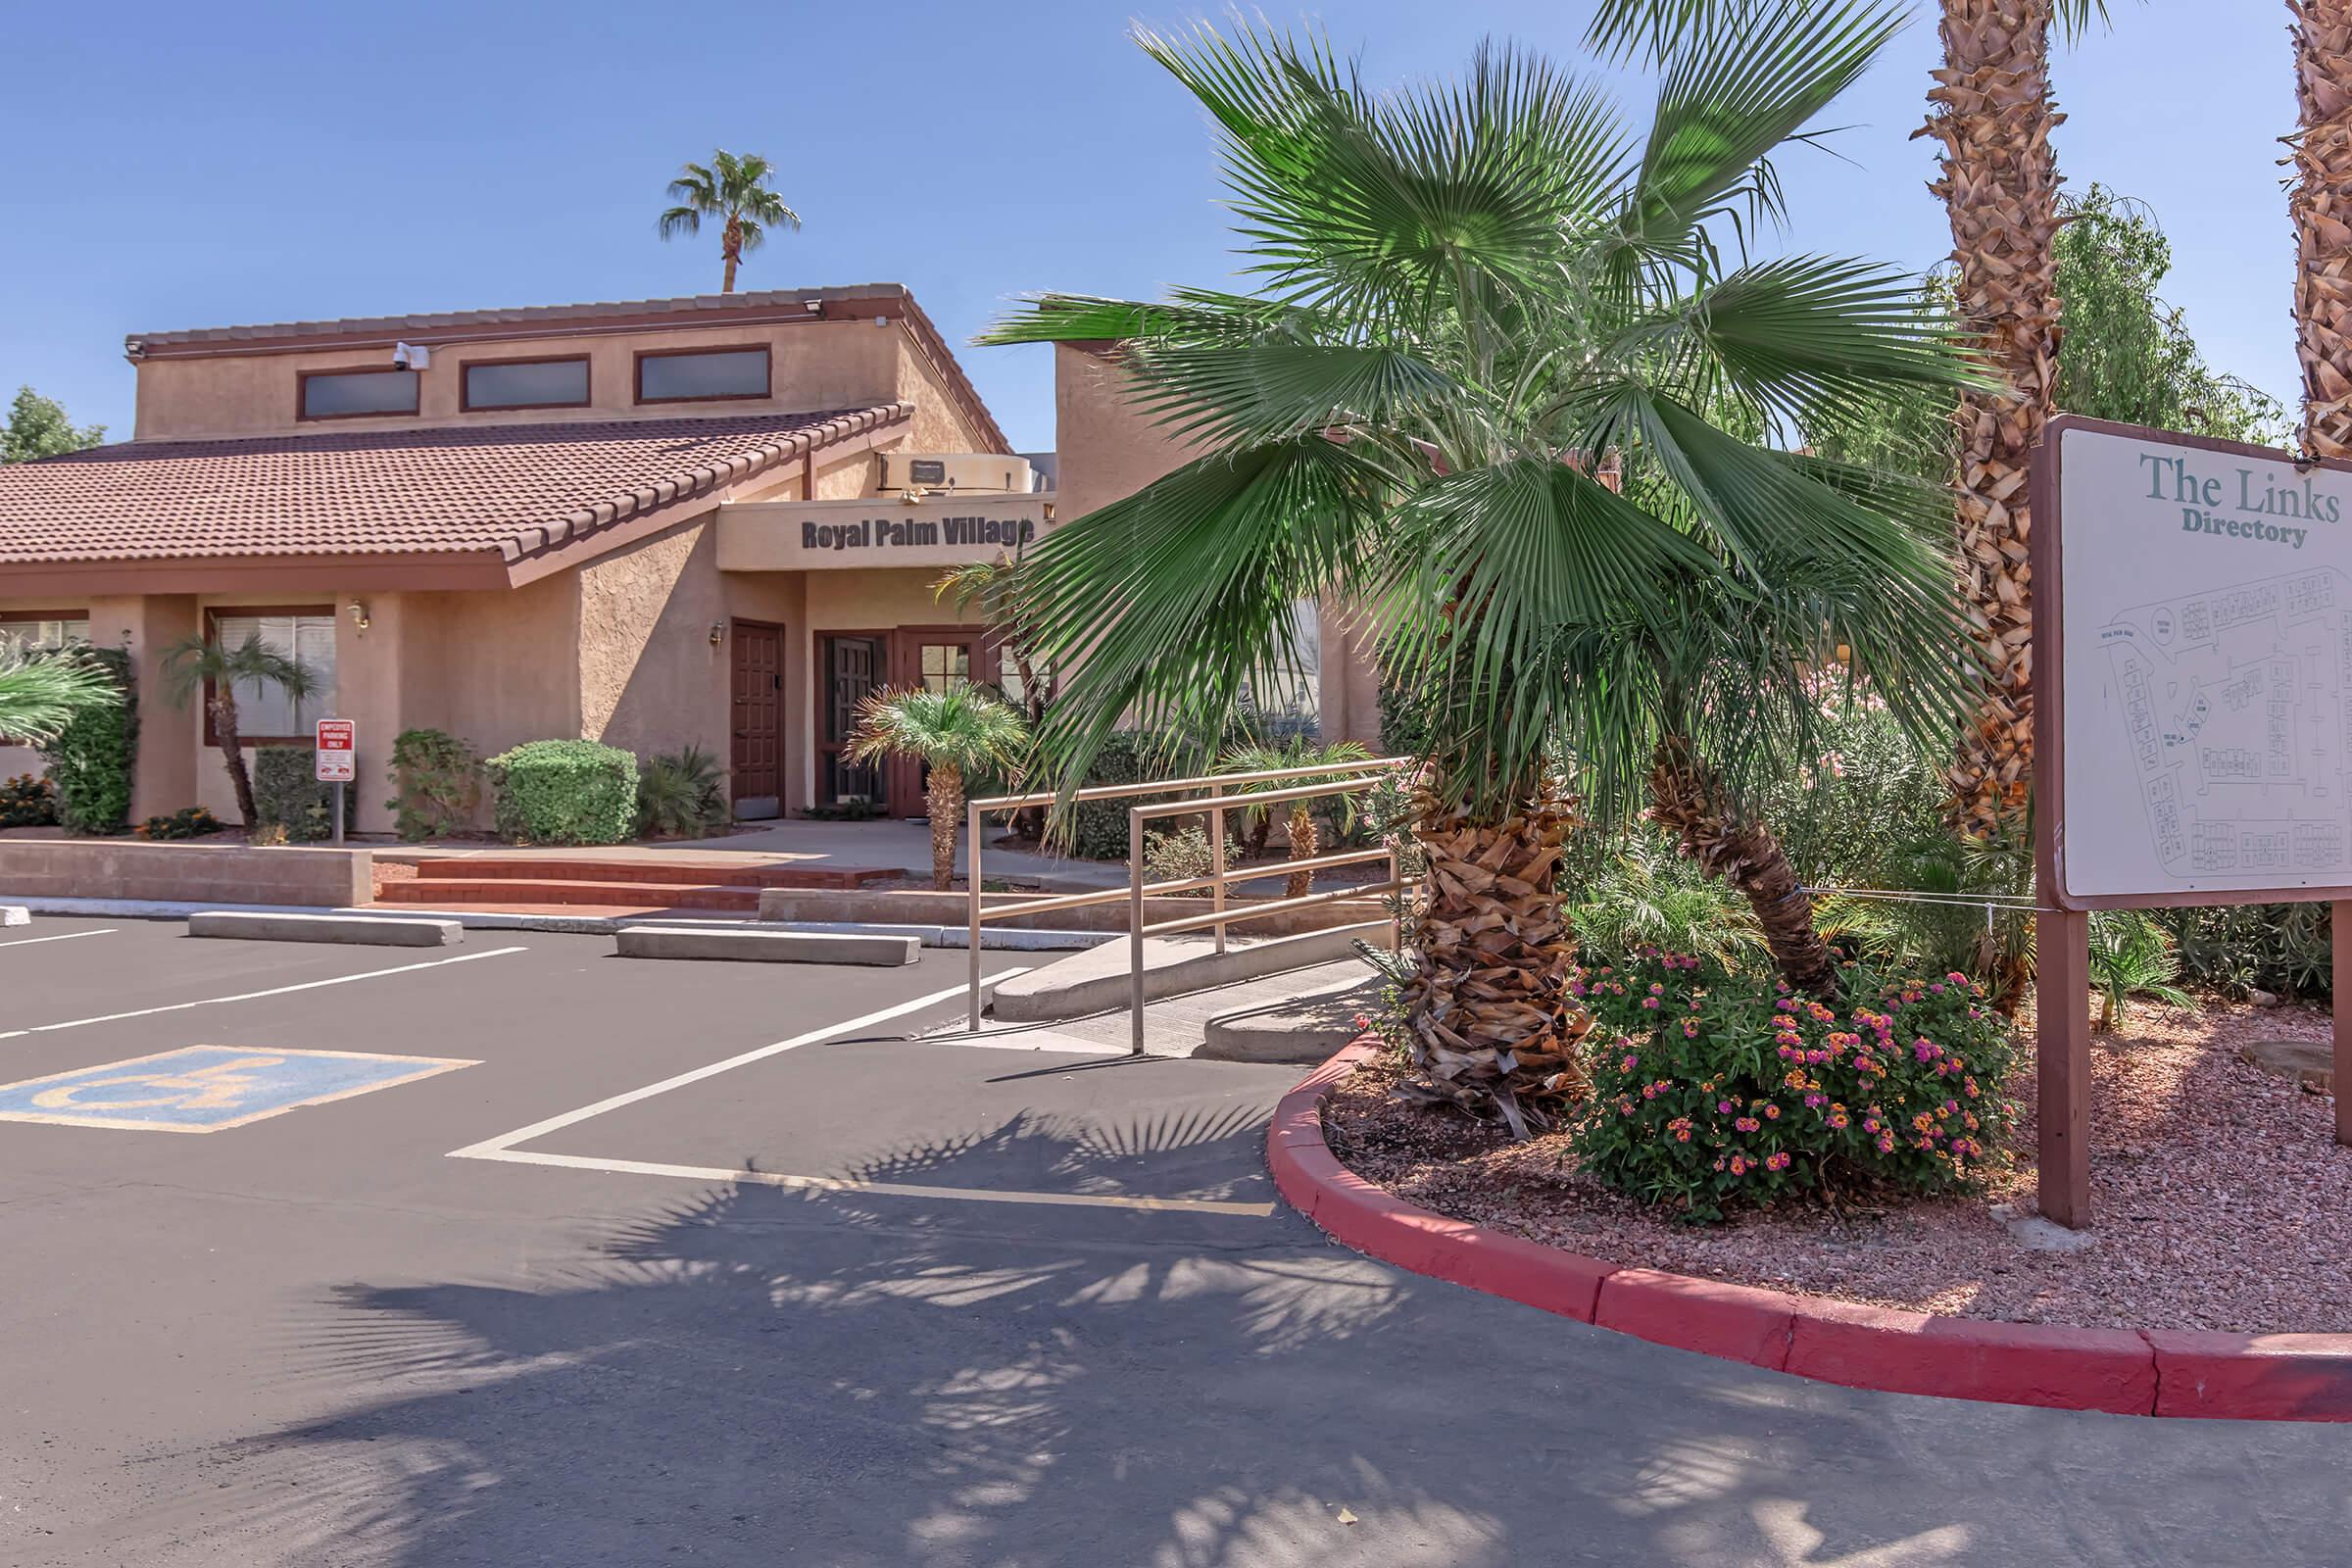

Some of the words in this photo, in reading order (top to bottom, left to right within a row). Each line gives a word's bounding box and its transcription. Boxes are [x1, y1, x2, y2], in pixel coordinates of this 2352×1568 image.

[2139, 452, 2223, 508] The
[2235, 468, 2340, 523] Links
[801, 519, 870, 551] Royal
[875, 517, 938, 547] Palm
[942, 515, 1035, 547] Village
[2181, 507, 2308, 550] Directory
